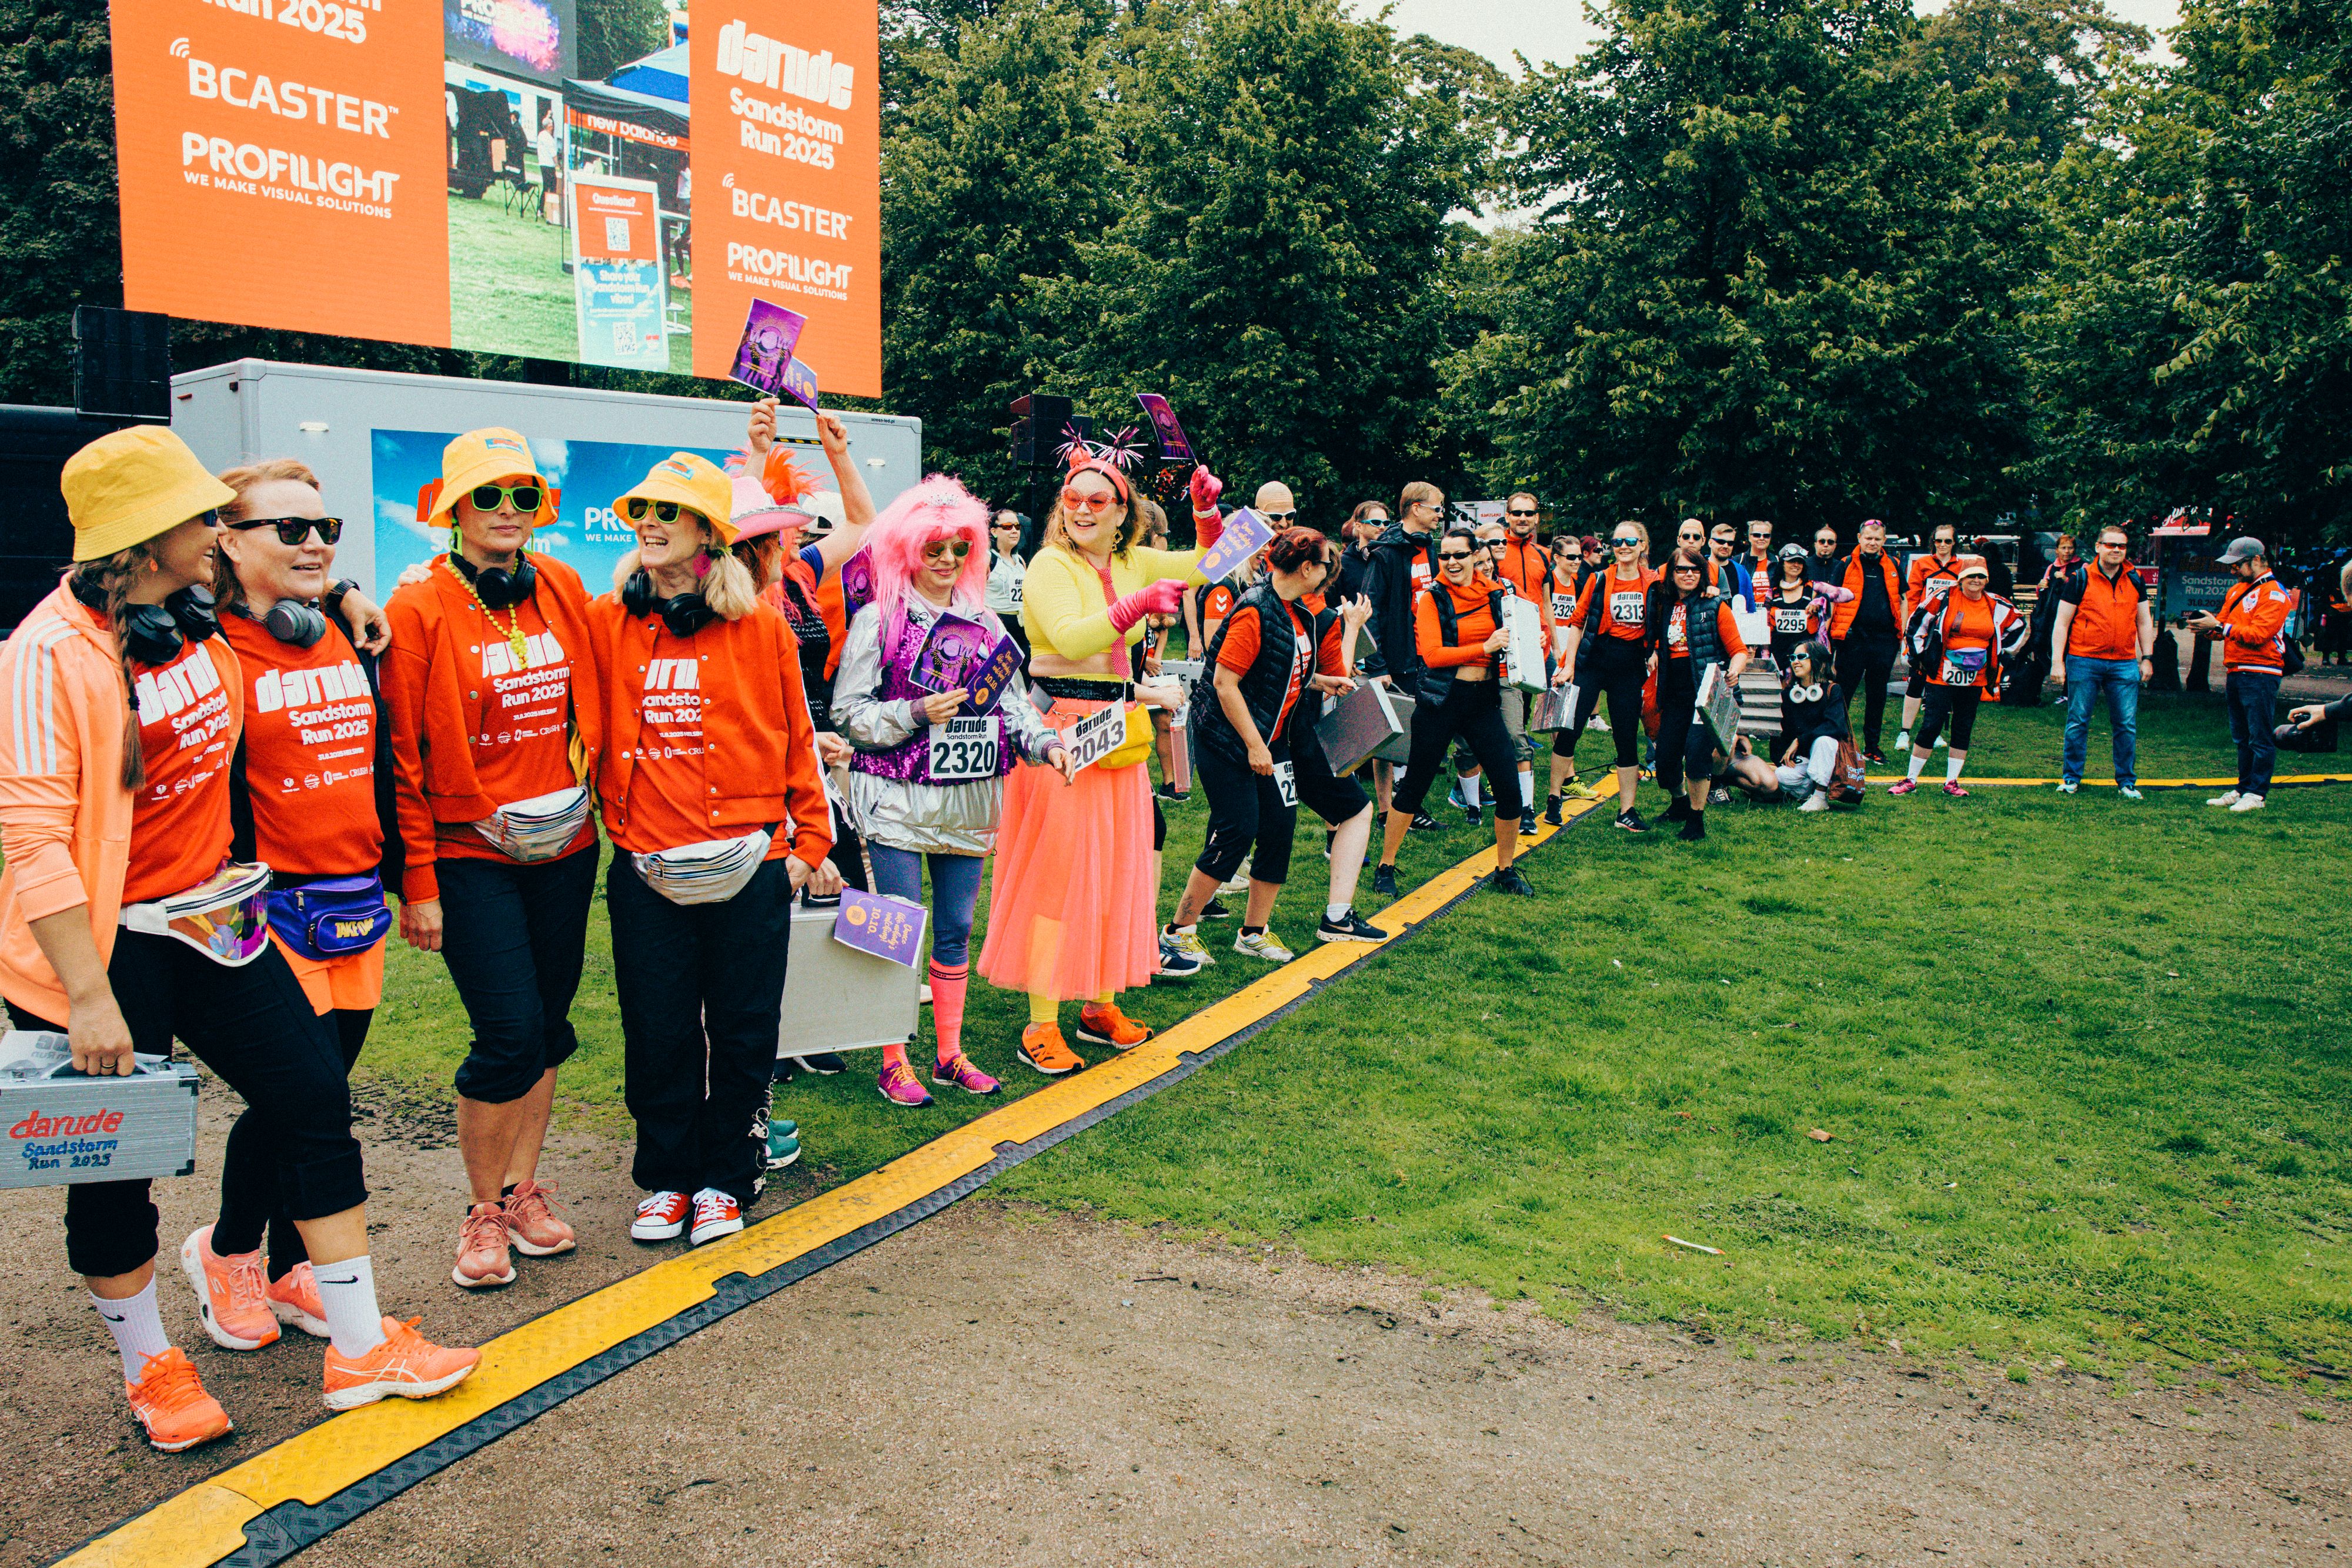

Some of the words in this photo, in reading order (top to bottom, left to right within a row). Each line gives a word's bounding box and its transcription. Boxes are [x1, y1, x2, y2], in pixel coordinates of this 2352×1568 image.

[278, 0, 367, 44] 2025
[717, 19, 854, 111] darude
[588, 115, 617, 132] new
[730, 87, 844, 145] Sandstorm
[741, 121, 781, 157] Run
[784, 133, 836, 170] 2025
[184, 170, 209, 186] WE
[214, 176, 257, 196] MAKE
[261, 185, 313, 205] VISUAL
[316, 195, 392, 219] SOLUTIONS
[728, 271, 743, 283] WE
[745, 273, 770, 287] MAKE
[771, 278, 802, 292] VISUAL
[803, 283, 848, 302] SOLUTIONS
[586, 533, 602, 542] WE
[604, 534, 632, 543] MAKE
[2205, 586, 2229, 596] 202
[1552, 603, 1575, 618] 2329
[1613, 604, 1645, 620] 2313
[1776, 619, 1805, 631] 2295
[255, 660, 372, 714] darude
[493, 666, 570, 693] Sandstorm
[984, 673, 998, 691] 10.10.
[1946, 670, 1975, 684] 2019
[502, 691, 530, 708] Run
[532, 681, 566, 702] 2025
[288, 703, 372, 727] Sandstorm
[644, 709, 674, 724] Run
[945, 718, 987, 734] darude
[1075, 708, 1112, 738] darude
[300, 728, 334, 745] Run
[333, 719, 369, 740] 2025
[1078, 724, 1103, 743] Sandstorm
[1103, 720, 1112, 728] Run
[933, 740, 995, 774] 2320
[1070, 720, 1124, 770] 2043
[867, 907, 881, 934] 10.10.
[901, 924, 913, 945] Dance
[9, 1108, 124, 1139] darude
[22, 1138, 118, 1159] Sandstorm
[28, 1158, 60, 1171] Run
[69, 1153, 112, 1167] 2025
